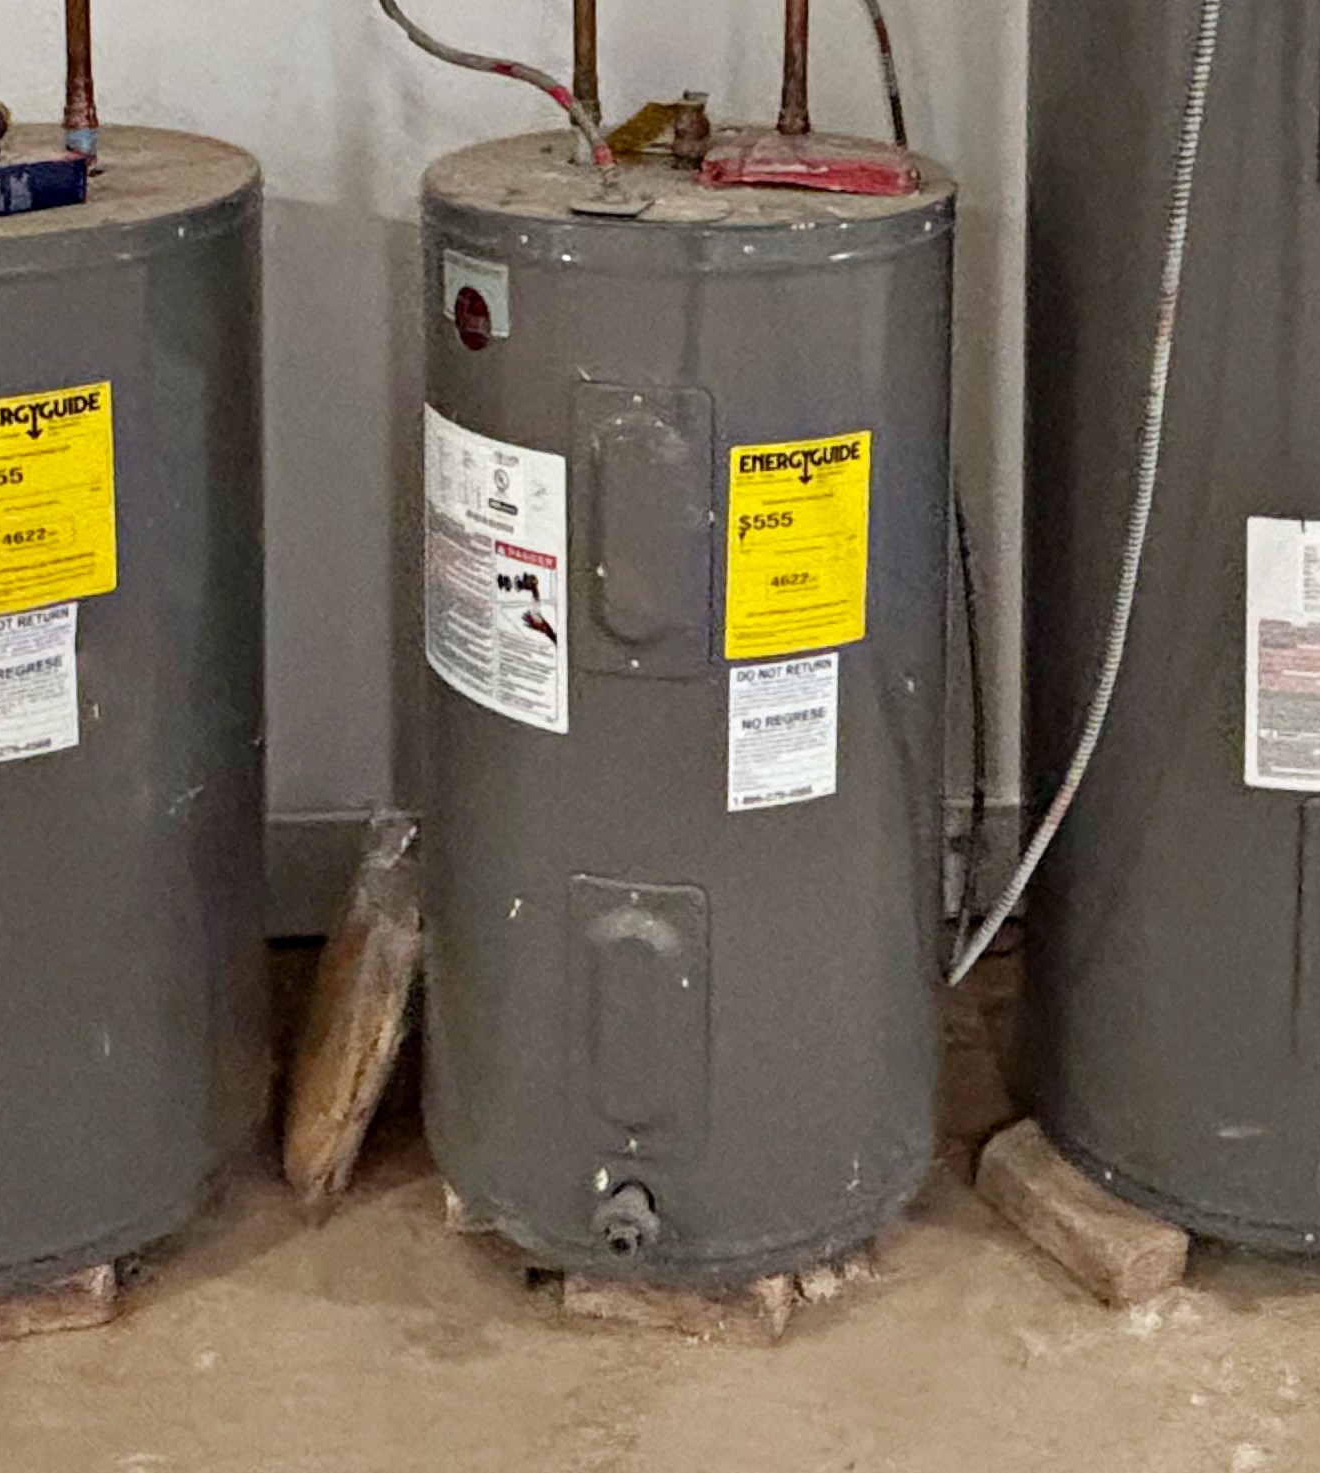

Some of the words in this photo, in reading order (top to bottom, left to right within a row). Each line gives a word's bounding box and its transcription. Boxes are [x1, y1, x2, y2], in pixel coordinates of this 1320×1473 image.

[739, 441, 861, 474] ENERGYGUIDE
[739, 511, 794, 531] $555
[2, 527, 47, 546] 4622
[17, 607, 70, 628] RETURN
[736, 670, 755, 683] DO
[758, 666, 783, 680] NOT
[786, 659, 833, 675] RETURN
[742, 718, 762, 731] NO
[765, 706, 827, 728] REGRESE
